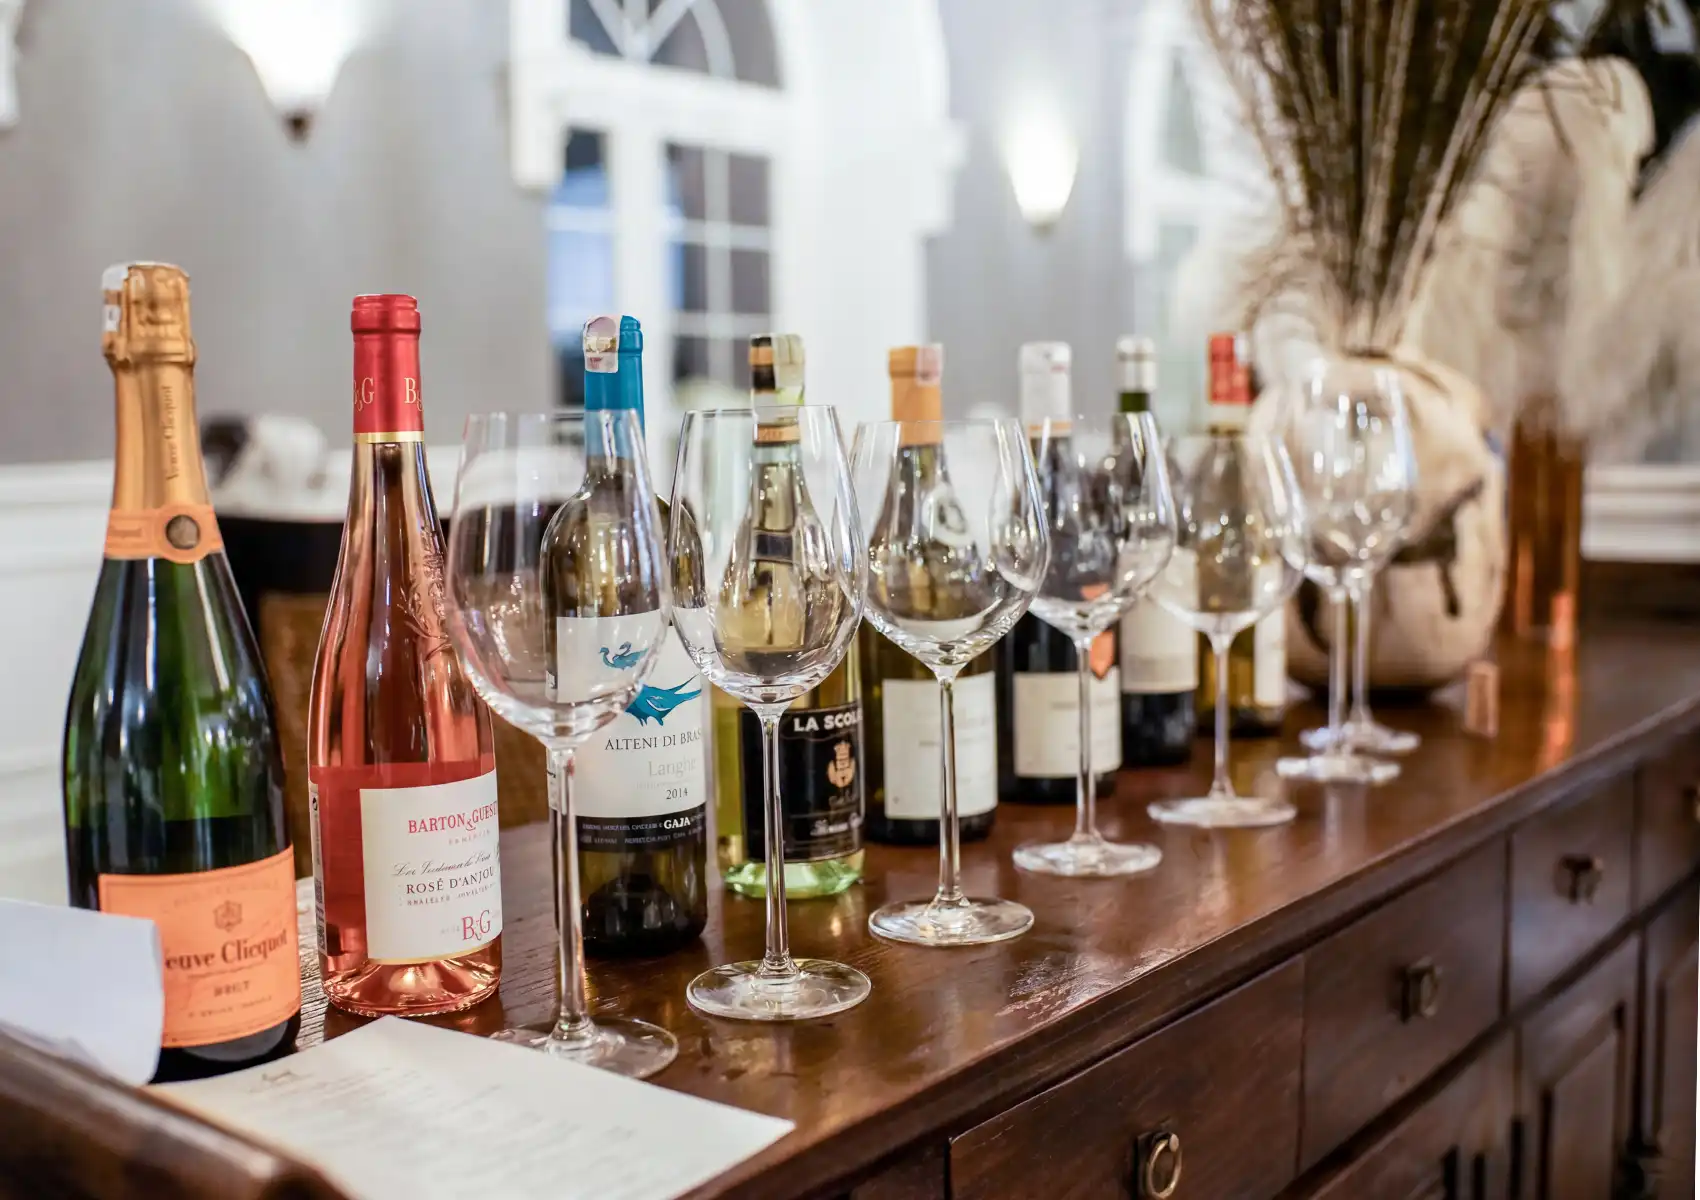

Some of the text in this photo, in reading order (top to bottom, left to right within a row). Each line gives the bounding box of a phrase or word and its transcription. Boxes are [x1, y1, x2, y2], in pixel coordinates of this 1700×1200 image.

[793, 716, 819, 732] LA
[605, 736, 658, 751] ALTENI
[663, 734, 676, 747] DI
[666, 787, 689, 800] 2014
[663, 816, 691, 829] GAJA
[406, 877, 444, 894] ROSÉ
[164, 952, 215, 970] euve
[221, 928, 287, 964] Clicquot
